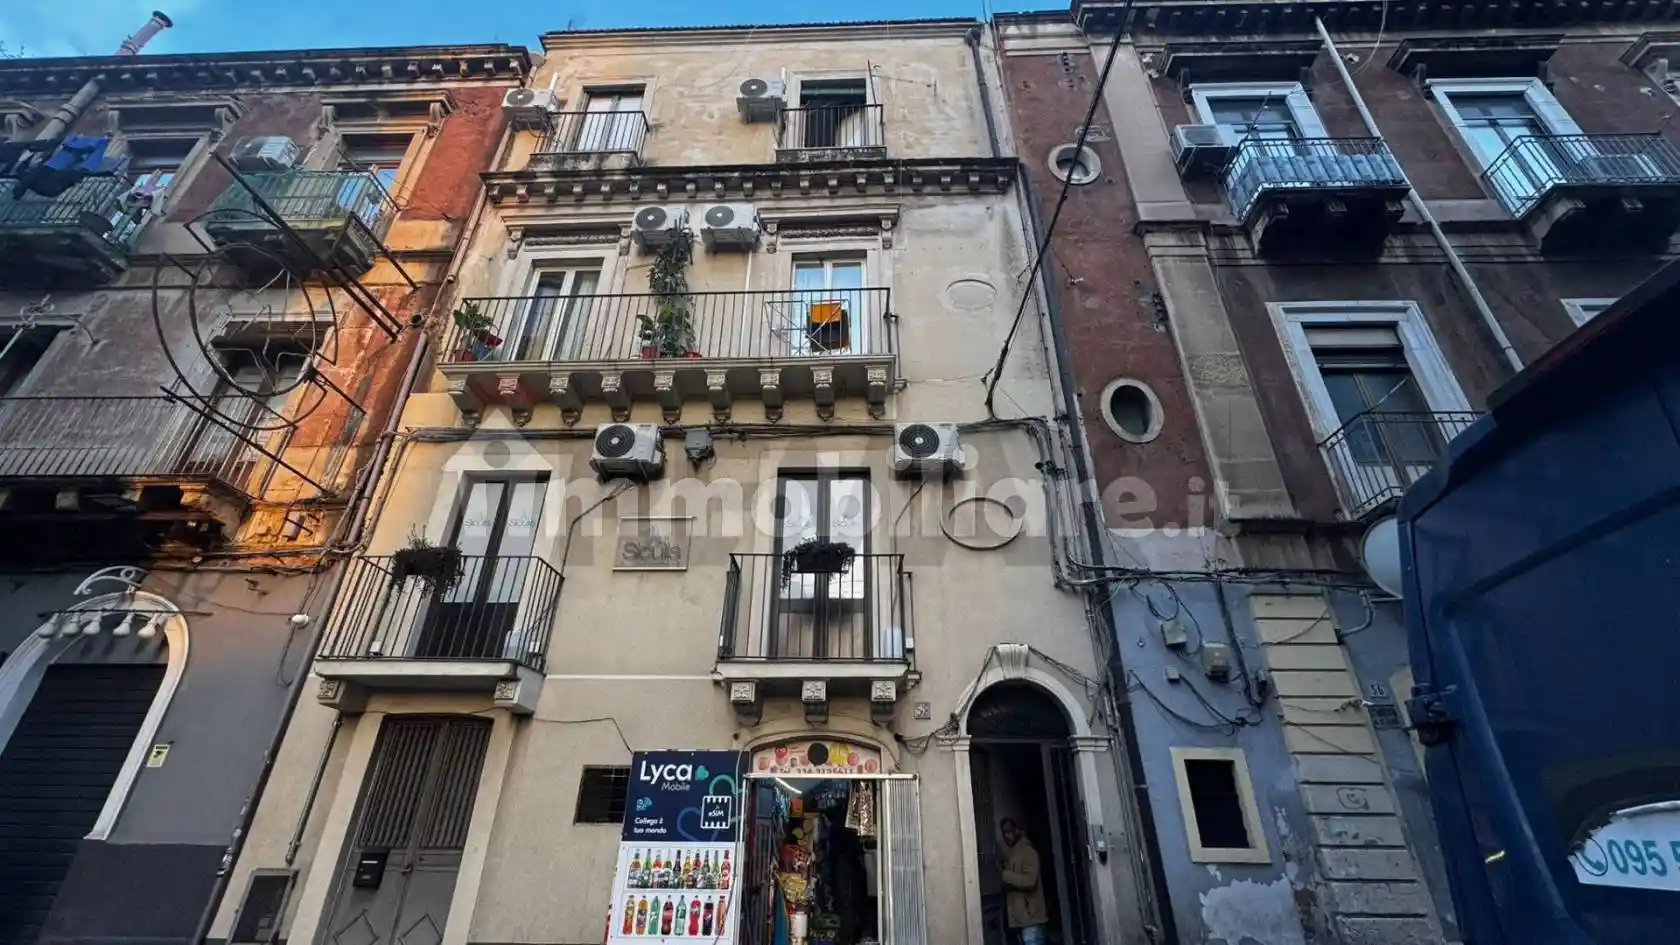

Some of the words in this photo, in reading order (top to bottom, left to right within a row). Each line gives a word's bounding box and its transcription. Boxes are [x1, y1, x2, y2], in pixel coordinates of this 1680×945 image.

[640, 760, 693, 785] Lyca
[661, 782, 690, 792] Mobile
[708, 809, 724, 817] eSIM
[1607, 839, 1668, 877] 095
